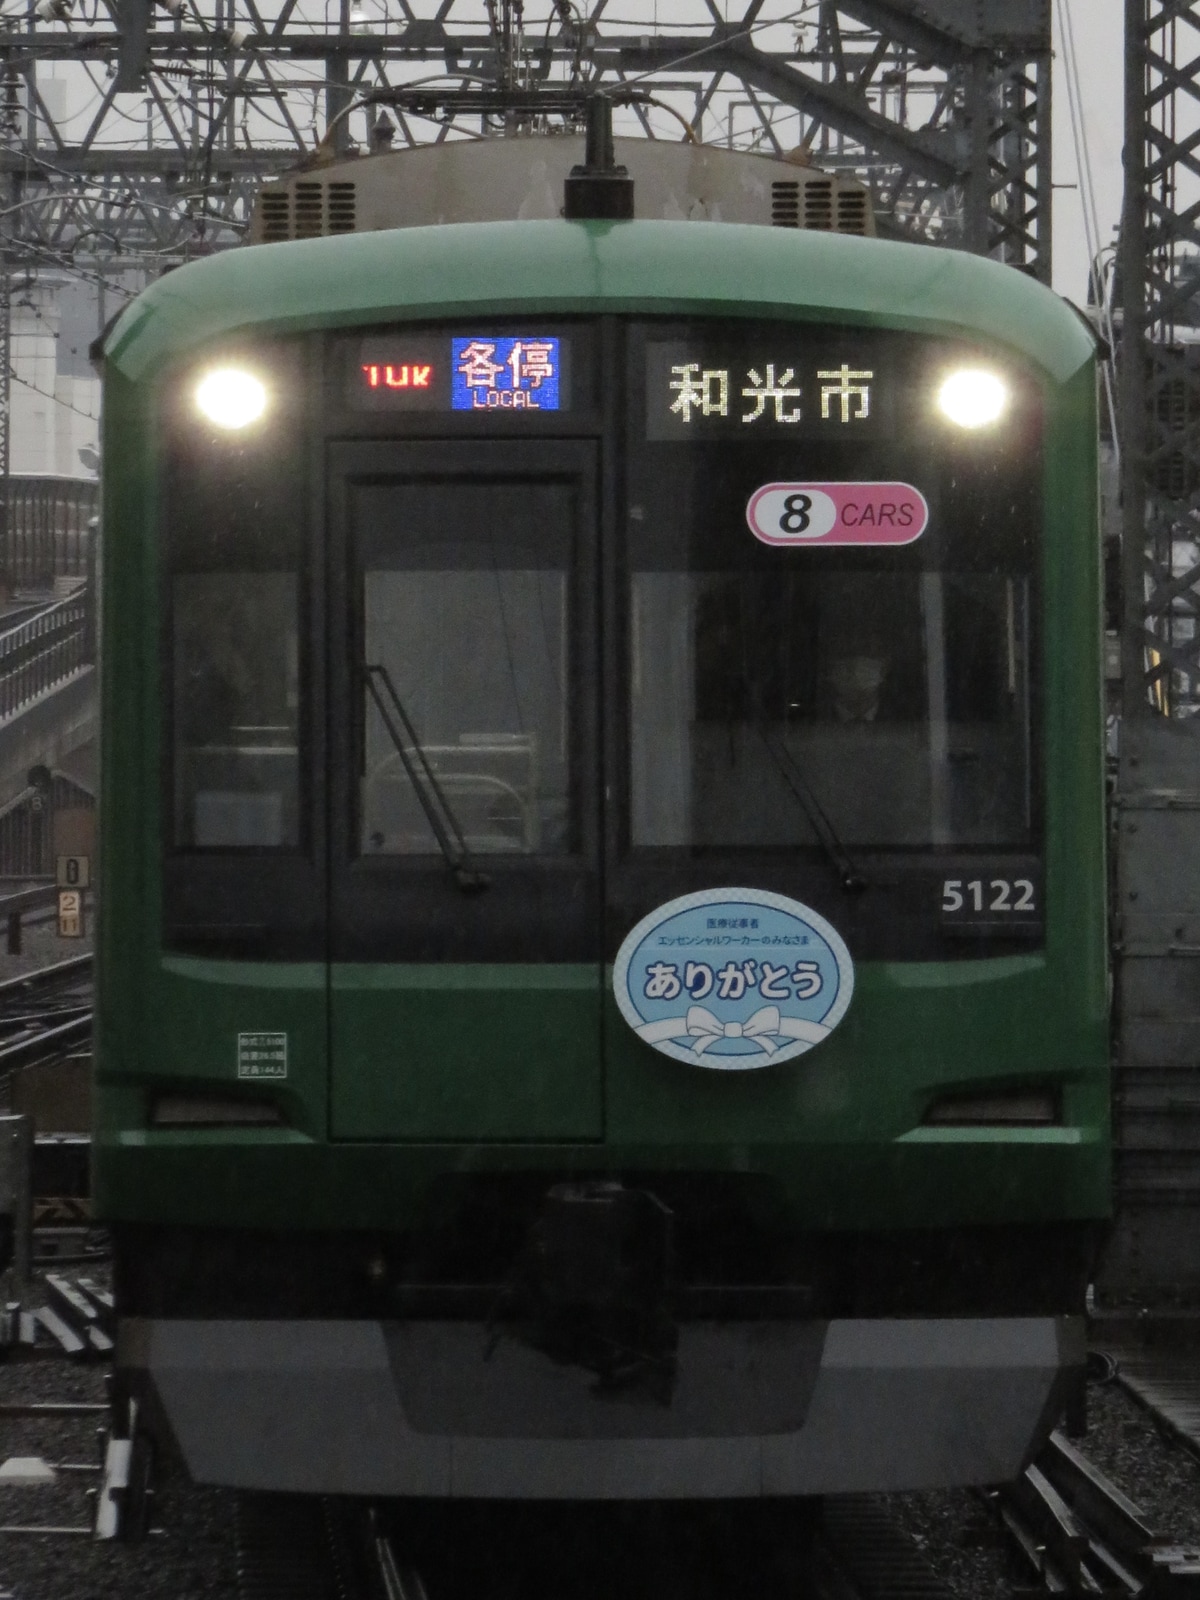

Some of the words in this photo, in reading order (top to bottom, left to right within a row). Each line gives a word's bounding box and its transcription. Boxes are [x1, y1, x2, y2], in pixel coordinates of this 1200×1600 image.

[459, 342, 553, 388] 各停
[473, 391, 539, 408] LOCAL
[669, 364, 873, 423] 和光市
[779, 494, 812, 534] 8
[841, 503, 914, 527] CARS
[62, 895, 77, 912] 2
[942, 880, 1035, 911] 5122
[706, 918, 759, 929] 医療従事者
[658, 935, 809, 946] エッセンシャルワーカーのみなさま
[644, 959, 823, 1000] ありがとう
